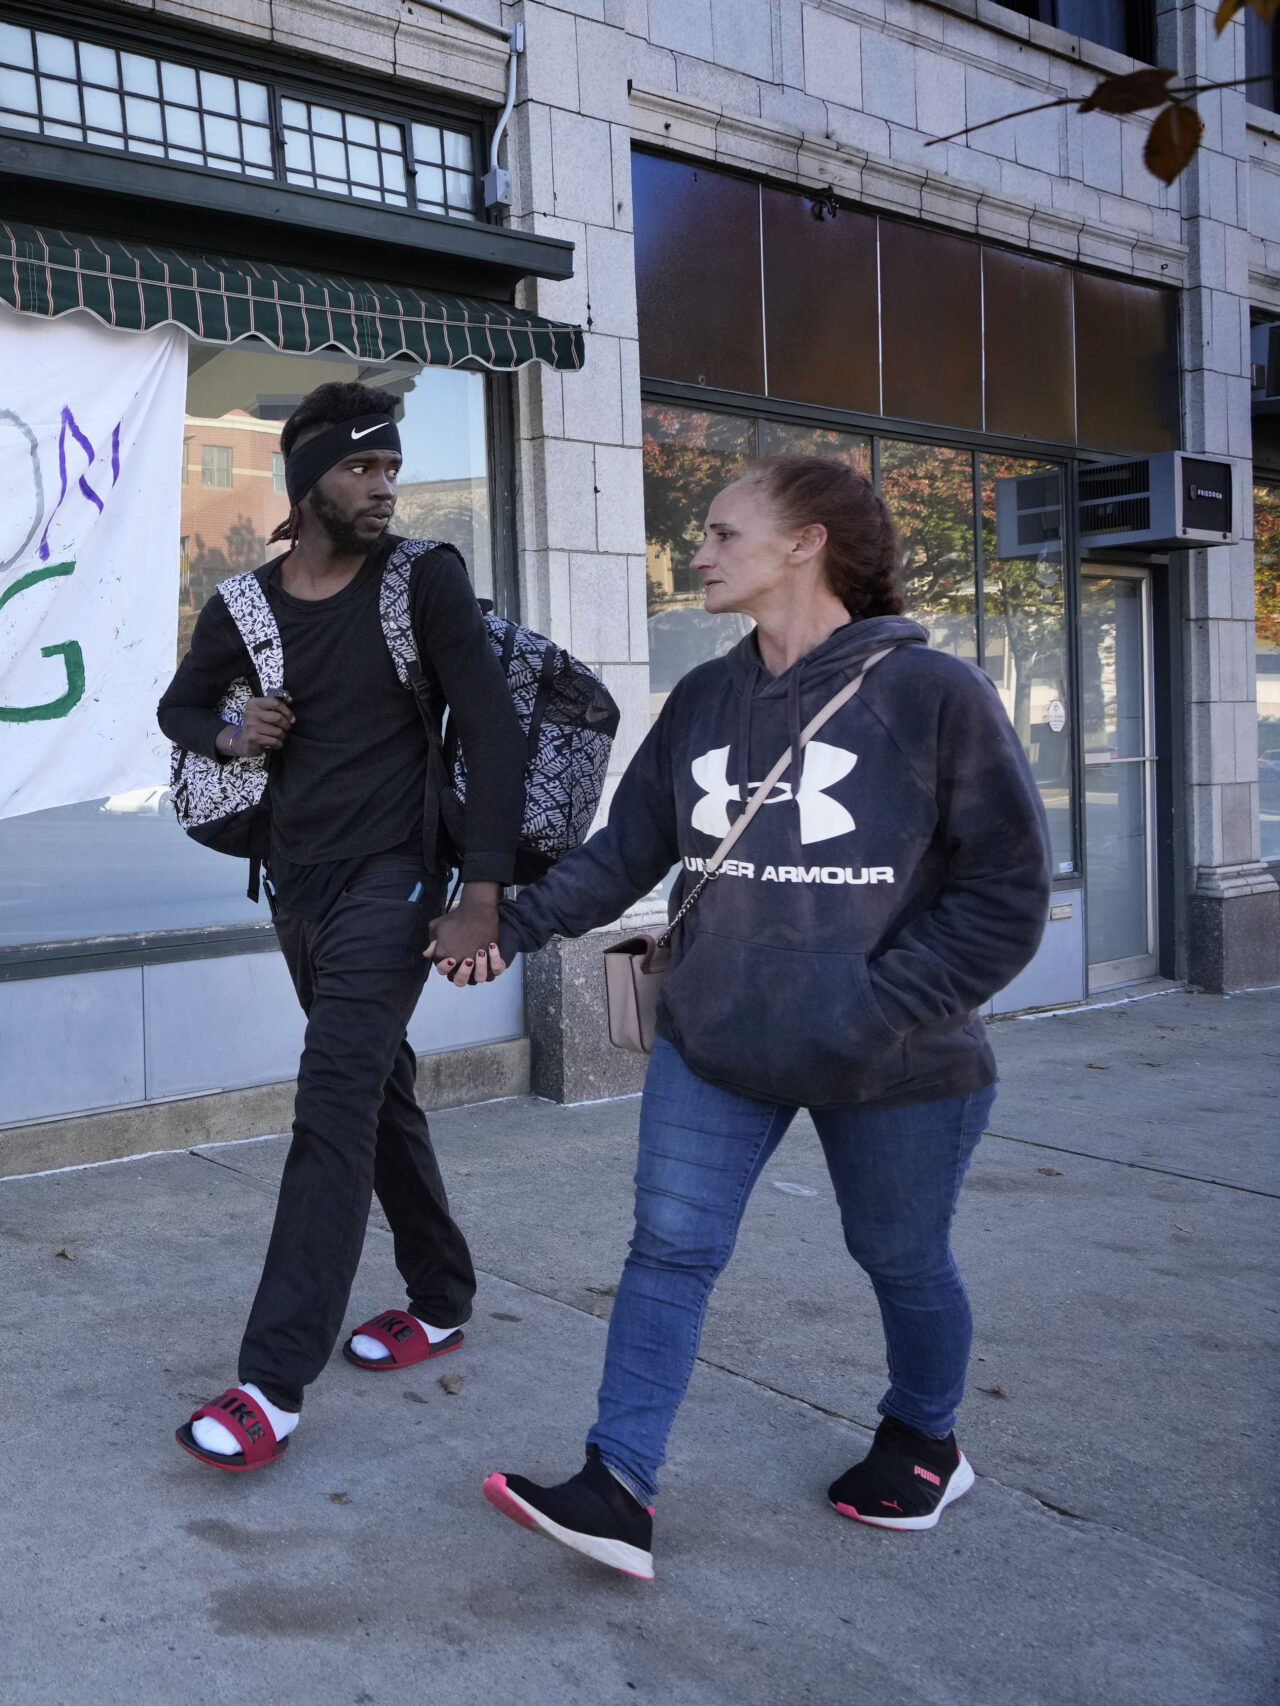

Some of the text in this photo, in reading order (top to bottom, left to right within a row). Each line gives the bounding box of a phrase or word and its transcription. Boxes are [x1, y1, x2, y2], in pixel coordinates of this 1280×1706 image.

[1197, 489, 1223, 500] FRIEDRICH
[507, 668, 534, 690] NIKE
[530, 785, 557, 808] NIKE
[544, 780, 571, 804] NIKE
[761, 865, 895, 885] ARMOUR
[913, 1464, 941, 1487] PUMA
